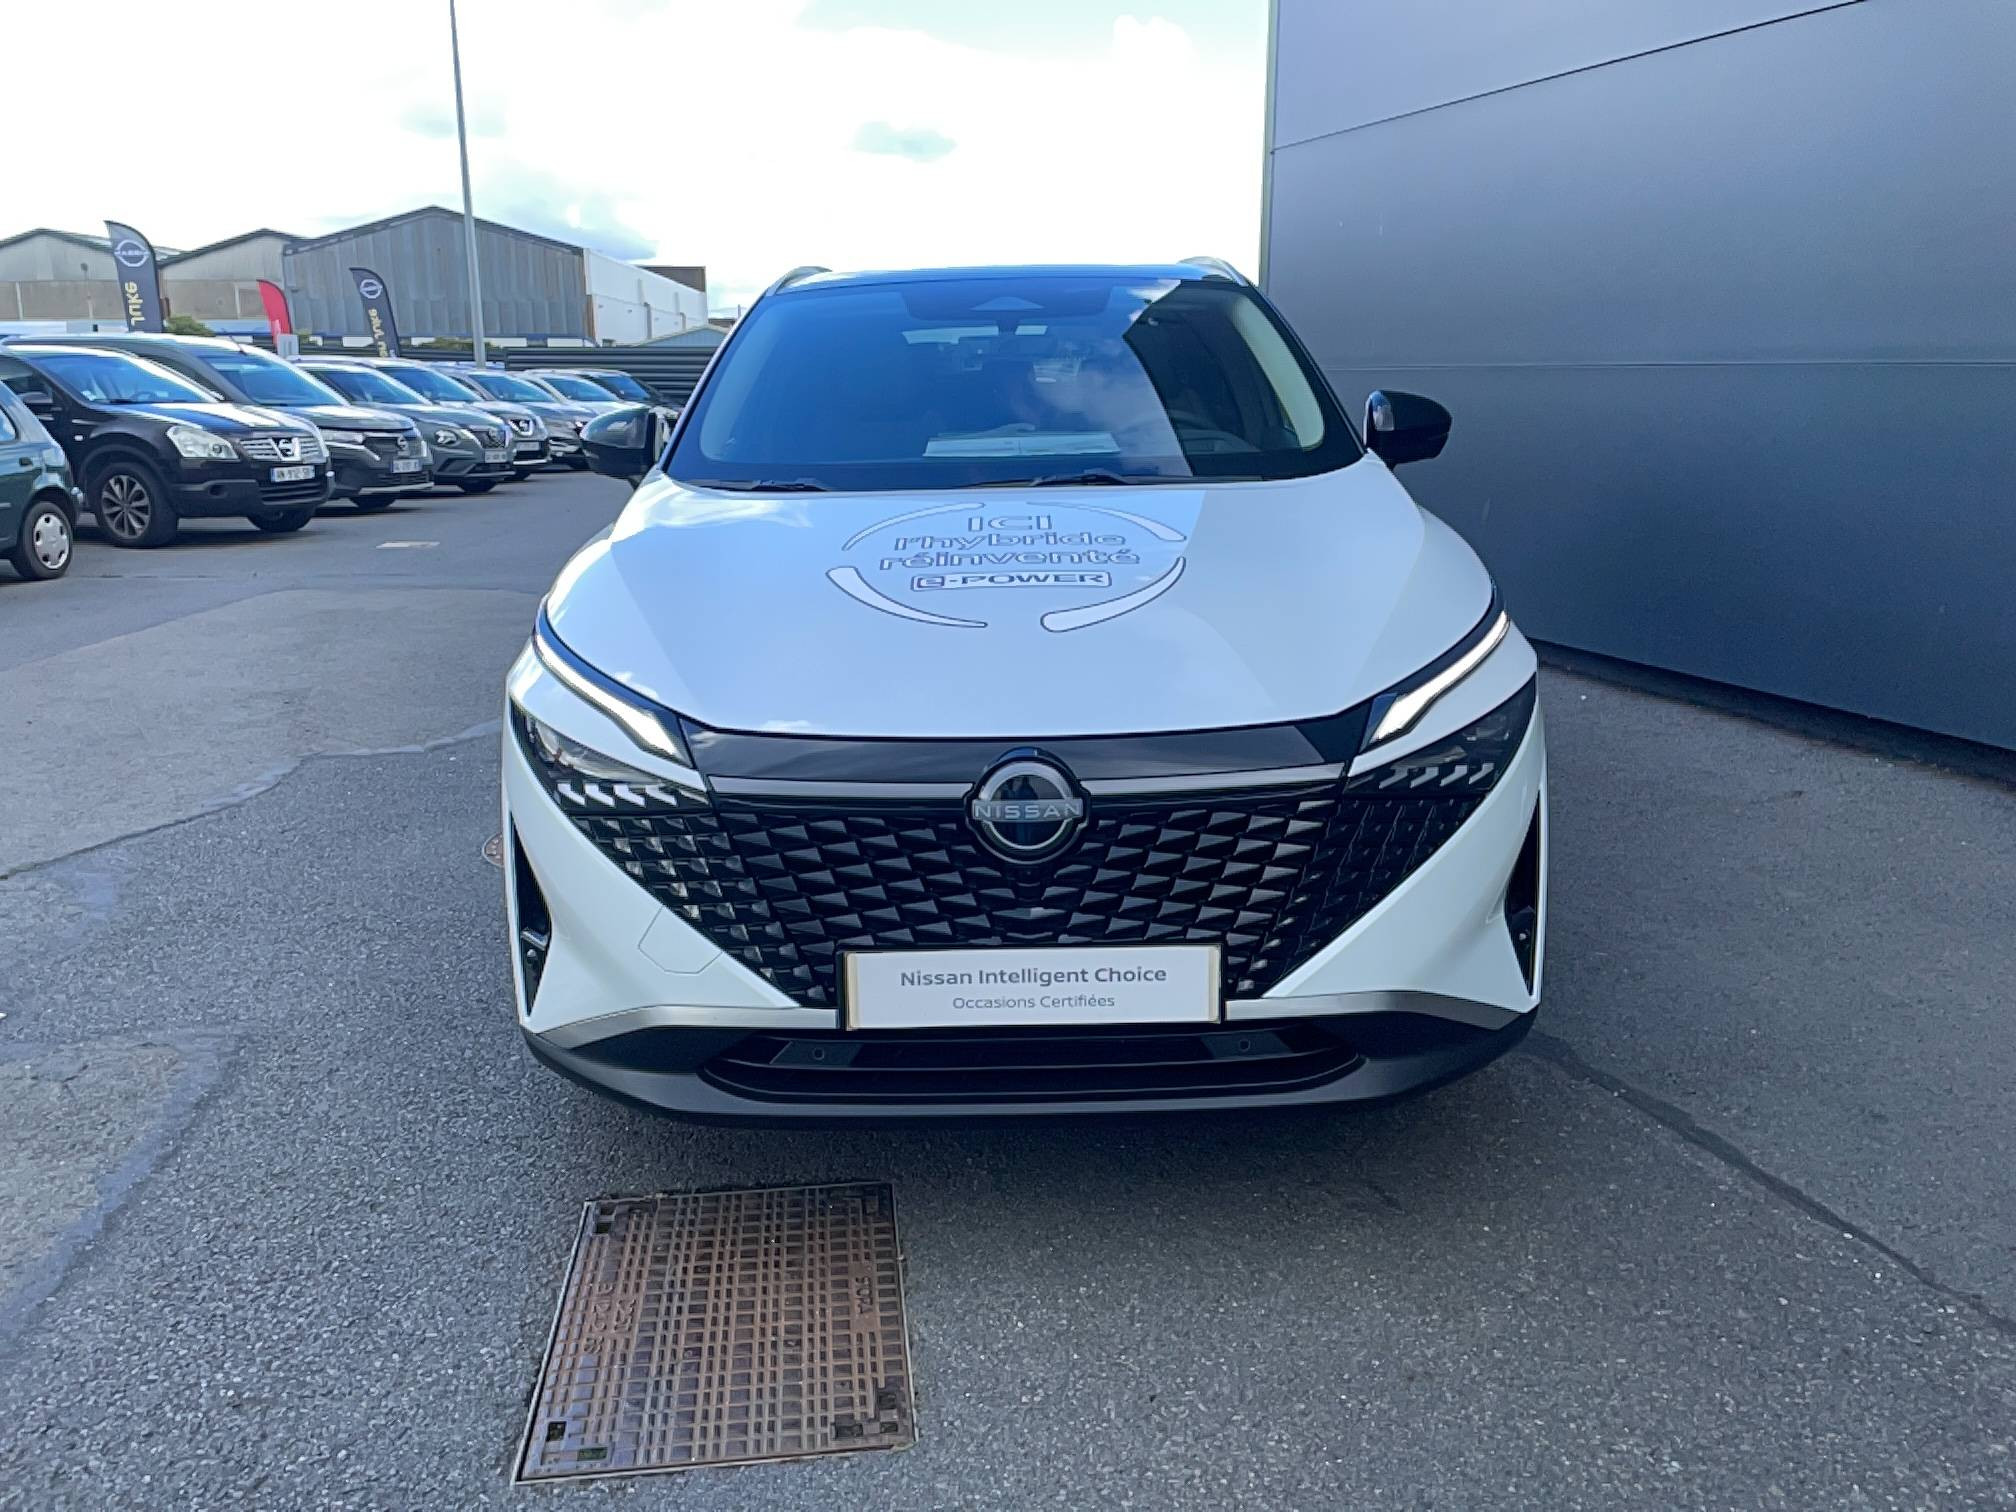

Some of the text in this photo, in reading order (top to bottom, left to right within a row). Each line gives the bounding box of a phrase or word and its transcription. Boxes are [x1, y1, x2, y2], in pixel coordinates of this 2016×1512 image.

[967, 514, 1053, 532] ICI
[880, 548, 1140, 571] réinventé
[974, 803, 1081, 818] NISSAN
[900, 966, 1167, 987] Nissan Intelligent Choice
[952, 994, 1116, 1009] Occasions Certifiées
